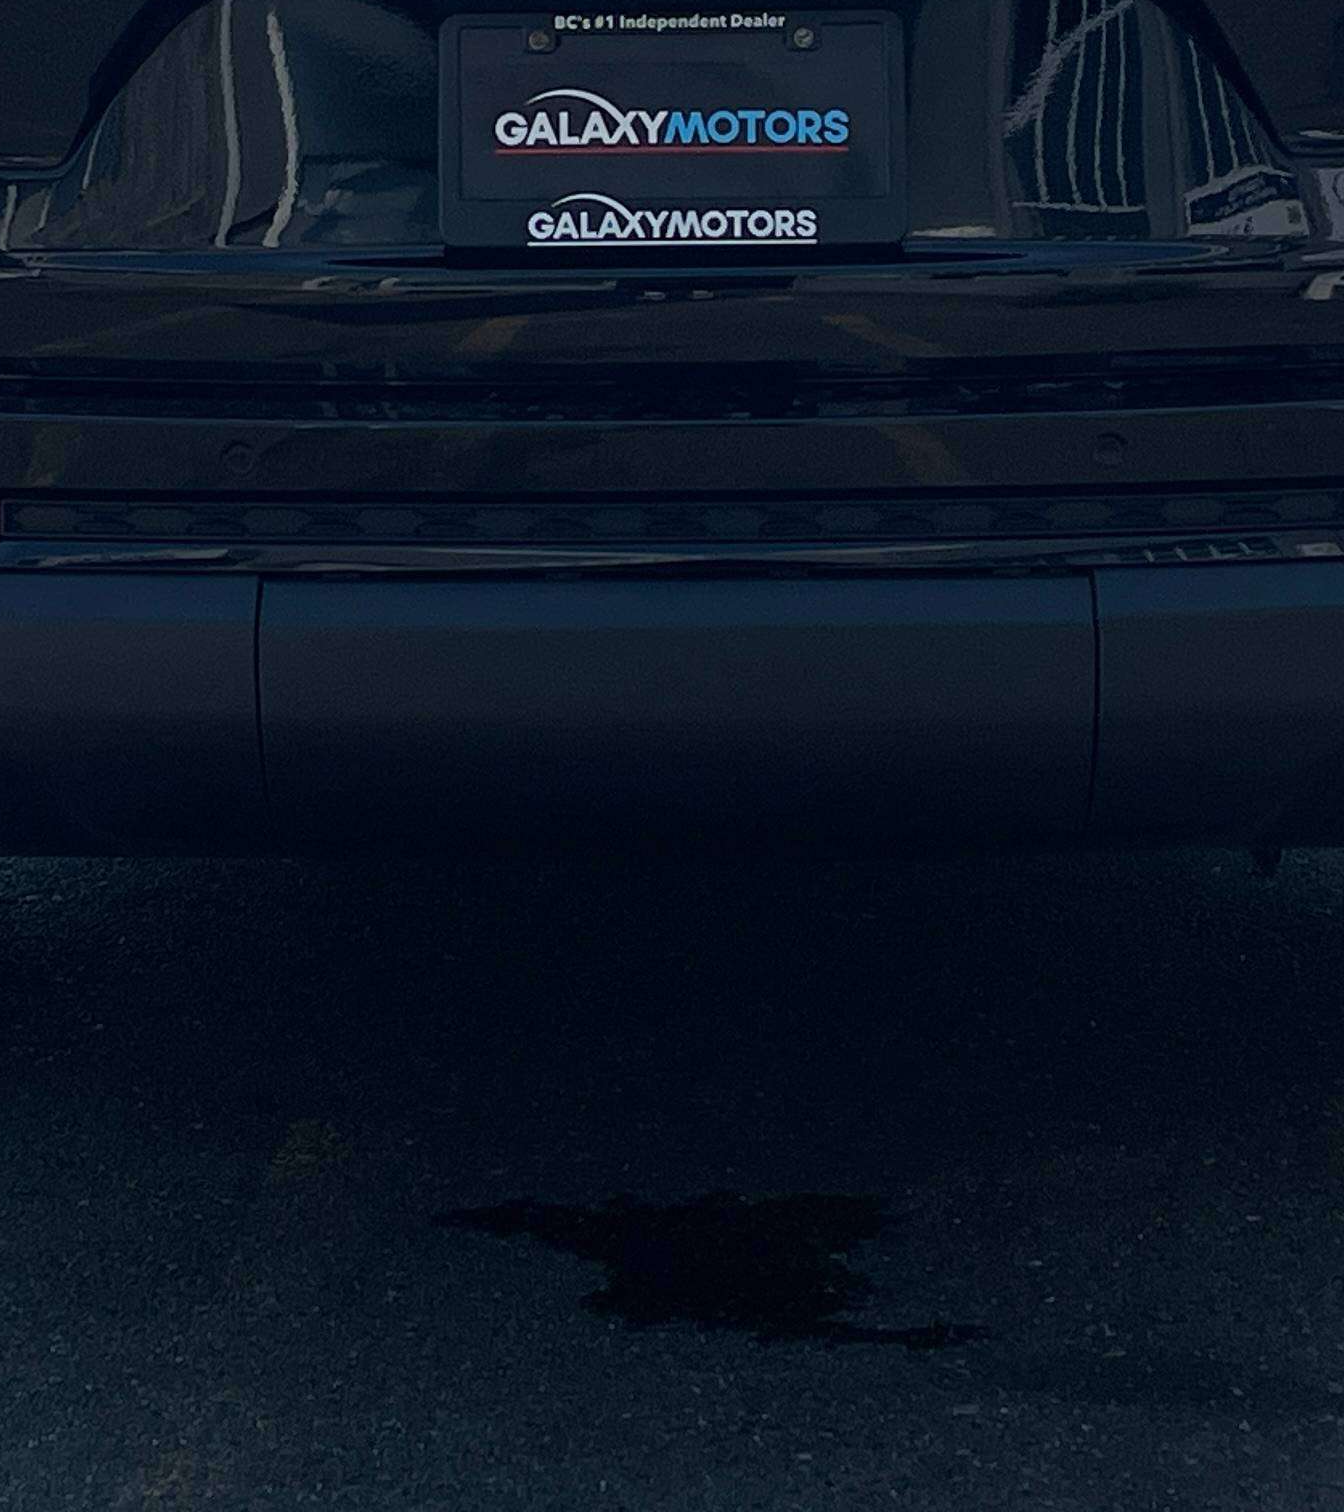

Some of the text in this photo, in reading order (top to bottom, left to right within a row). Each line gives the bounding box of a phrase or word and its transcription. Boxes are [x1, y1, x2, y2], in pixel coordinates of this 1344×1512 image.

[554, 13, 786, 32] BC's #1 Independent Dealer
